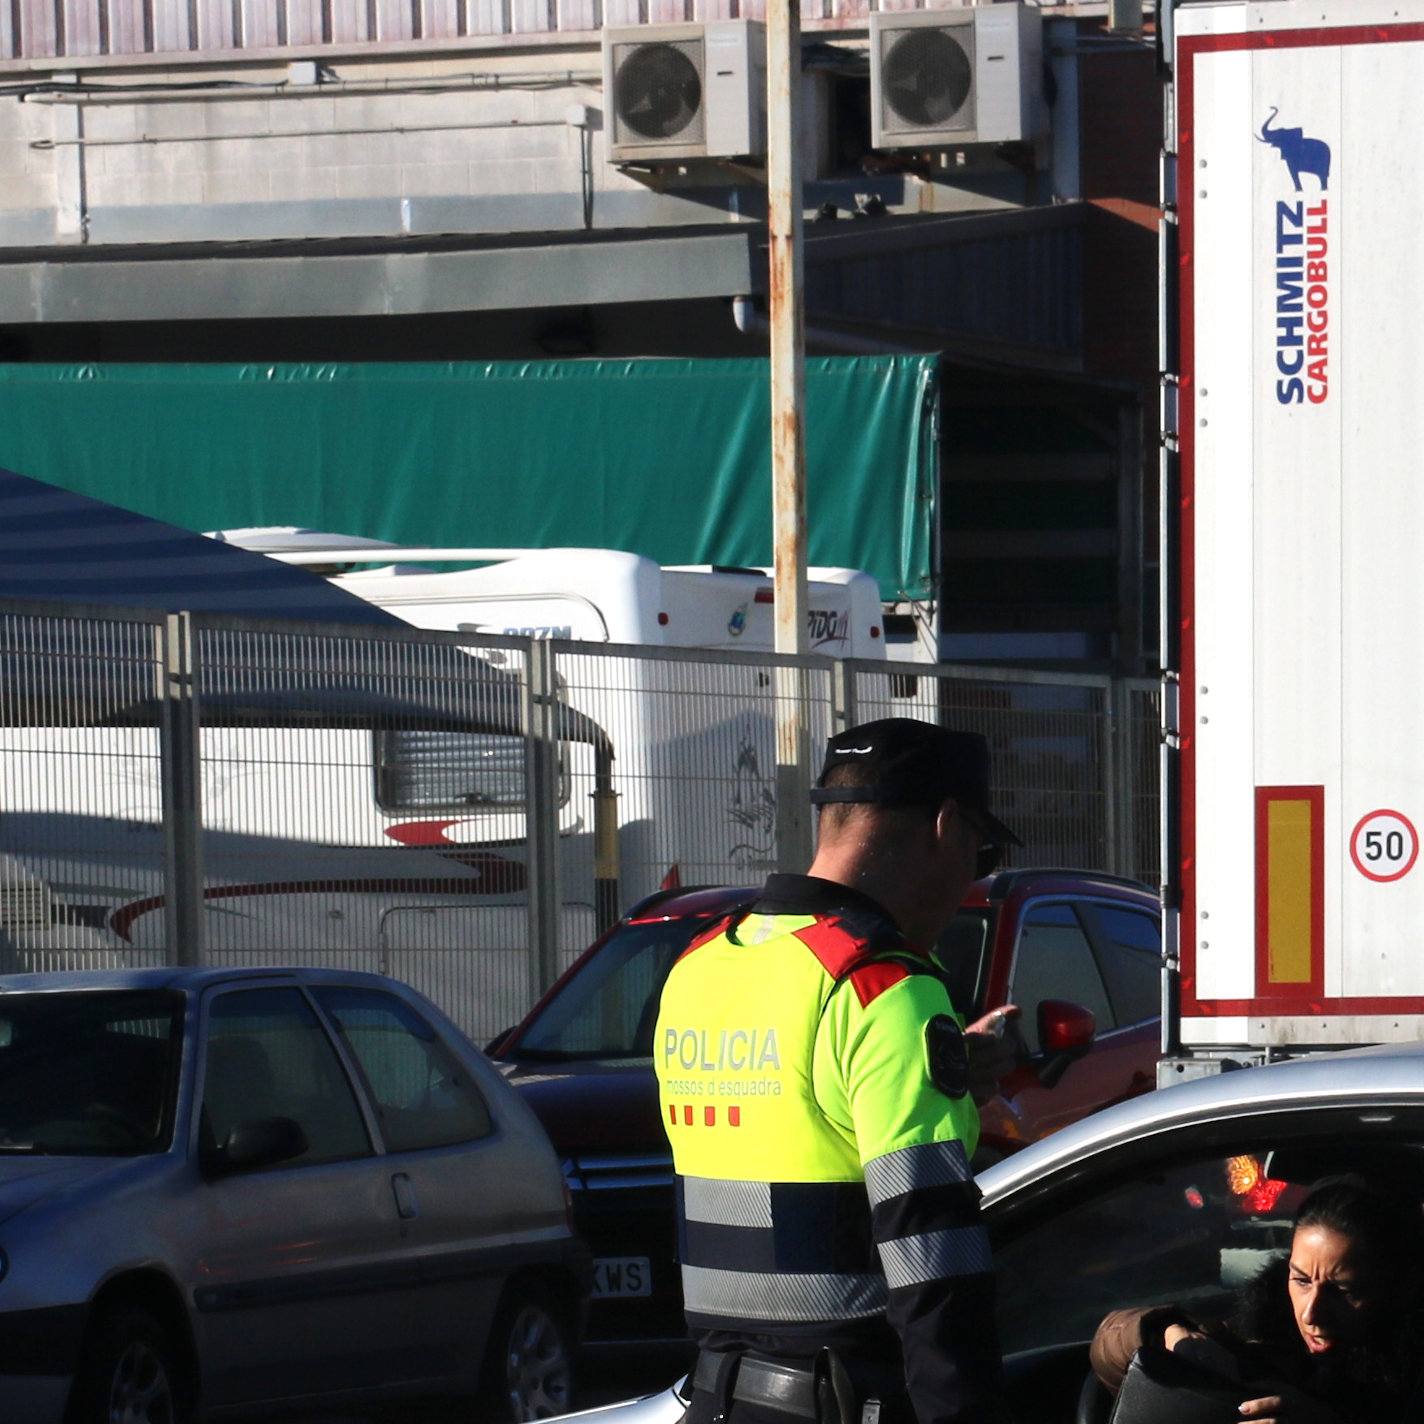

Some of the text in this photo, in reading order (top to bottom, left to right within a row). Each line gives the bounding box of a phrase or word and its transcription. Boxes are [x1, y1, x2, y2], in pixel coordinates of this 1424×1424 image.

[1276, 200, 1304, 405] SCHMITZ
[1306, 199, 1328, 405] CARGOBULL
[1365, 830, 1404, 861] 50
[664, 1028, 781, 1071] POLICIA
